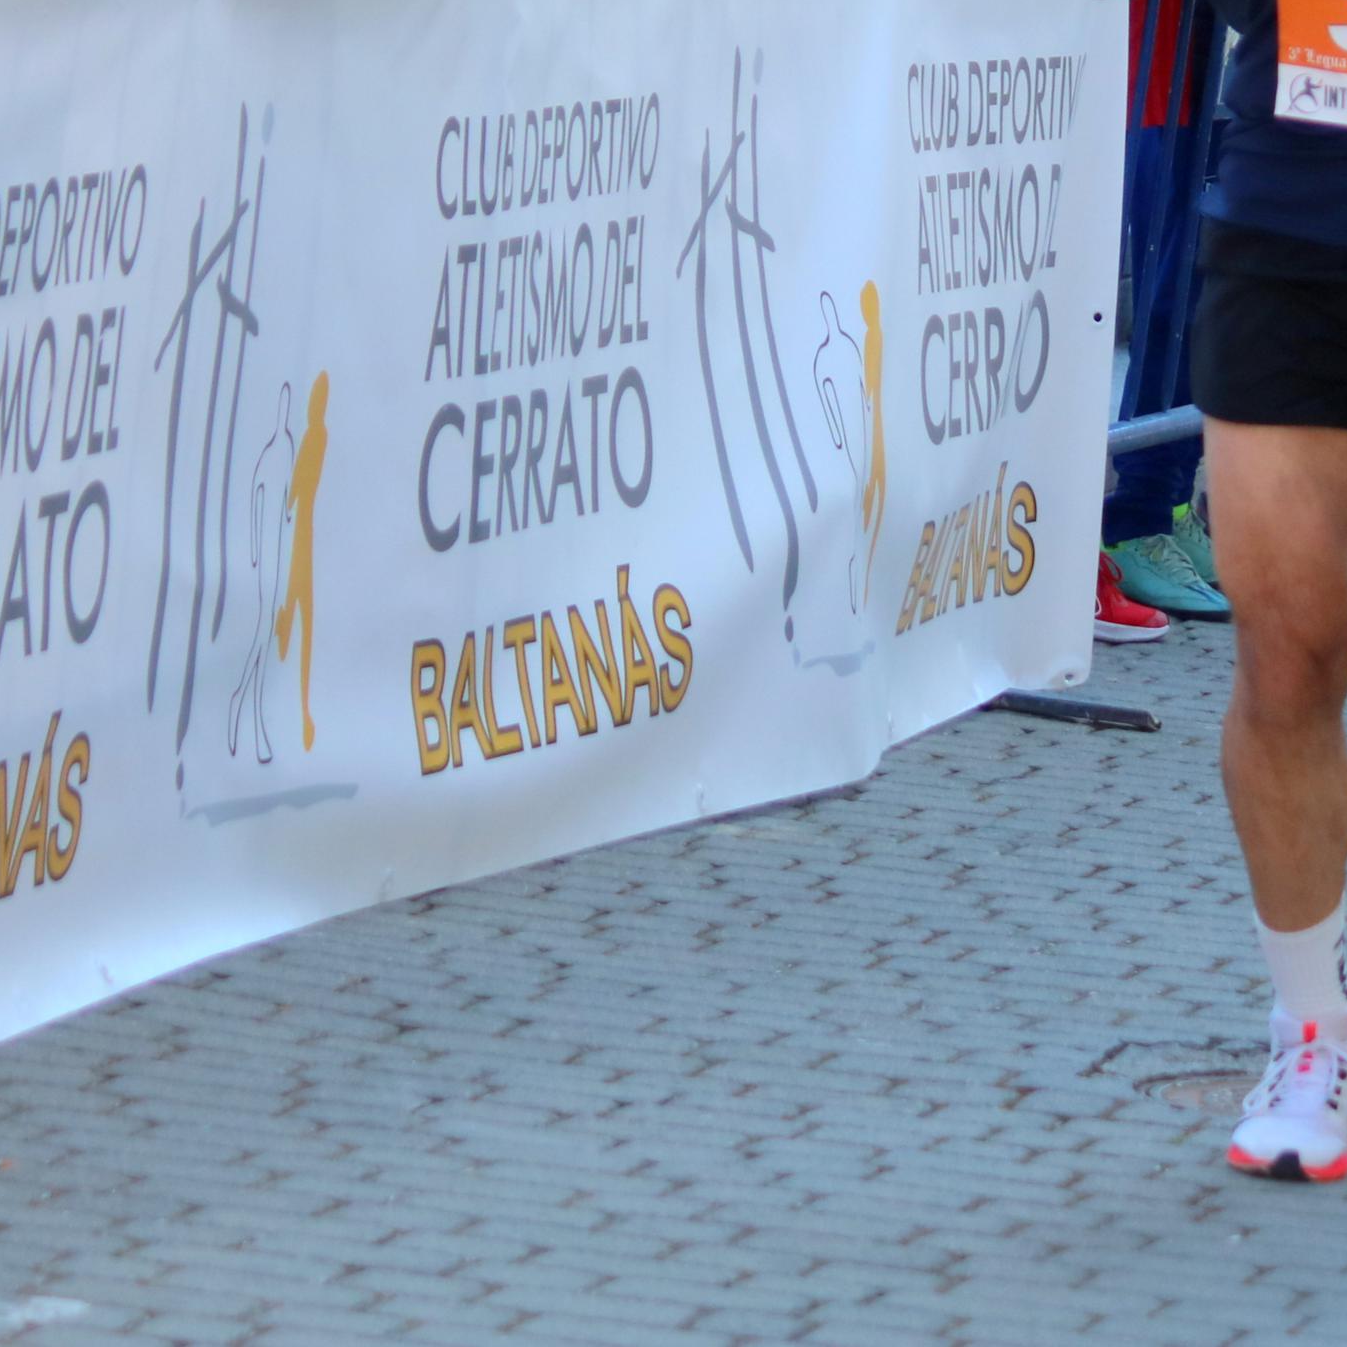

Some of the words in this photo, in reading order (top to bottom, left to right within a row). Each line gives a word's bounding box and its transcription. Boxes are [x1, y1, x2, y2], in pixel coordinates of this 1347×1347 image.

[907, 61, 960, 154] CLUB
[1304, 47, 1347, 70] Legua
[435, 114, 515, 221] CLUB
[519, 92, 661, 209] DEPORTIVO
[424, 222, 595, 383] ATLETISMO
[598, 214, 650, 344] DEL
[917, 163, 1041, 296] ATLETISMO
[62, 305, 127, 453] DEL
[418, 366, 654, 553] CERRATO
[409, 563, 694, 778] BALTANÁS
